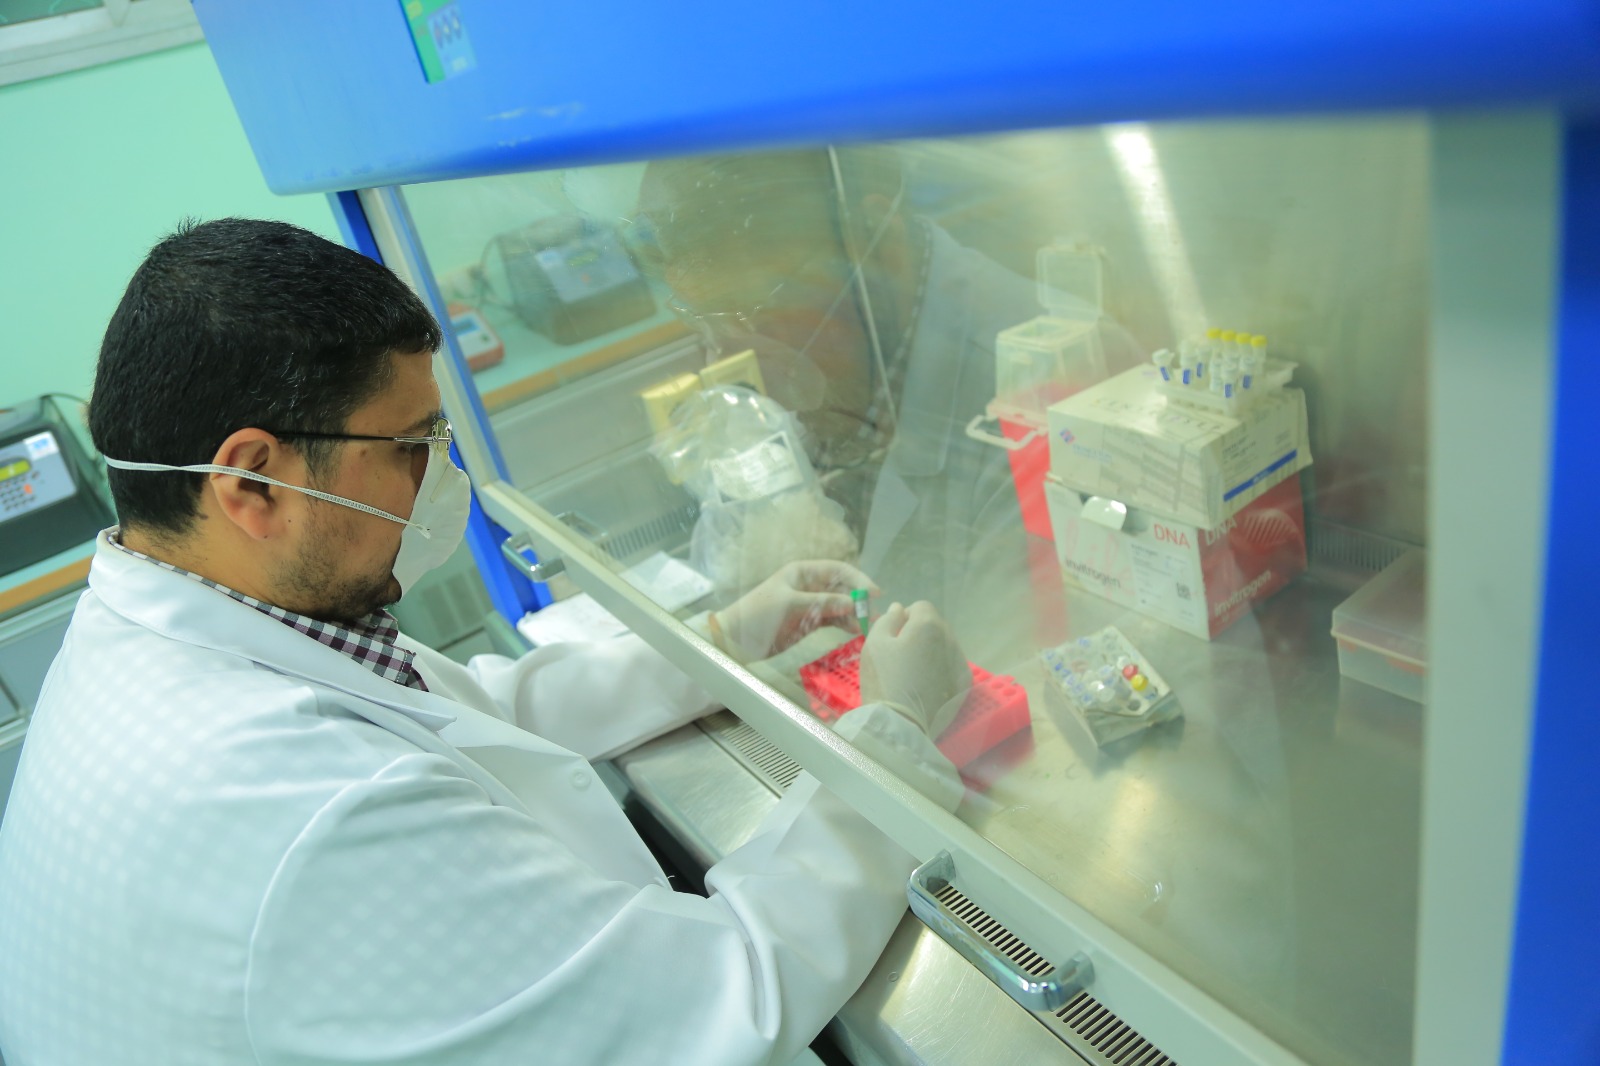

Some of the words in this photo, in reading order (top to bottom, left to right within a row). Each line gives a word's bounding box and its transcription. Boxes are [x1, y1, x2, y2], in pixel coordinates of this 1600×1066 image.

[1154, 522, 1191, 549] DNA
[1205, 517, 1238, 546] DNA
[1064, 556, 1121, 589] invitrogen
[1214, 570, 1272, 617] invitrogen
